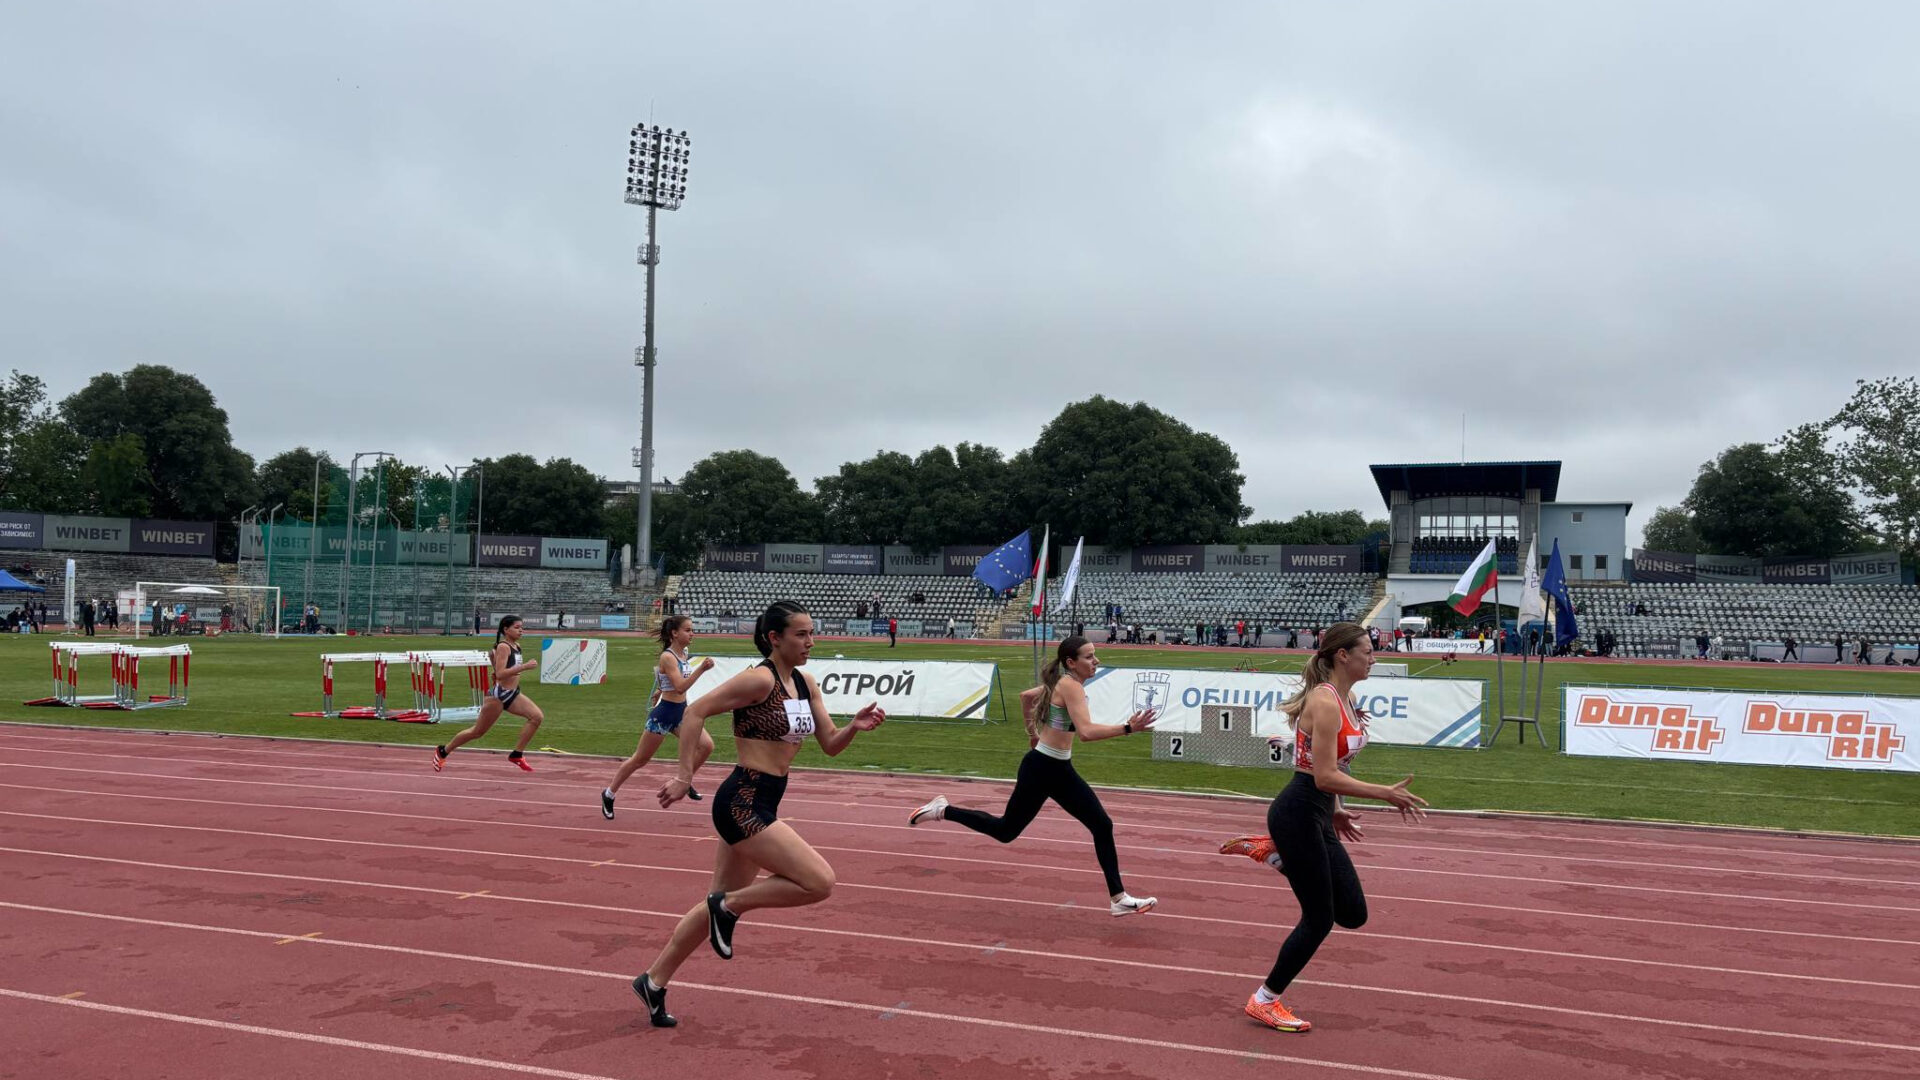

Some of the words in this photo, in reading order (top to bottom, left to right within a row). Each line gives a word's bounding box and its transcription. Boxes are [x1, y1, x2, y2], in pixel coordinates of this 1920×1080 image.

[56, 526, 122, 541] WINBET
[142, 530, 206, 545] WINBET
[249, 535, 311, 549] WNBET
[481, 544, 536, 557] WINBET
[548, 547, 601, 560] WINBET
[710, 551, 760, 563] WINBET
[770, 553, 818, 565] WINBET
[889, 555, 939, 566] WINBET
[1083, 555, 1122, 566] INBET
[1142, 554, 1193, 566] WINBET
[1216, 555, 1270, 566] WINBET
[1291, 555, 1347, 567] WINBET
[1634, 559, 1695, 573] WINBET
[1698, 564, 1758, 576] WINBET
[1764, 564, 1828, 577] WINBET
[1831, 561, 1898, 575] WINBET
[1579, 698, 1687, 727] Duna
[794, 716, 812, 734] 353
[1221, 711, 1230, 730] 1
[1747, 704, 1864, 735] Duna
[1171, 737, 1182, 756] 2
[1270, 744, 1282, 762] 3
